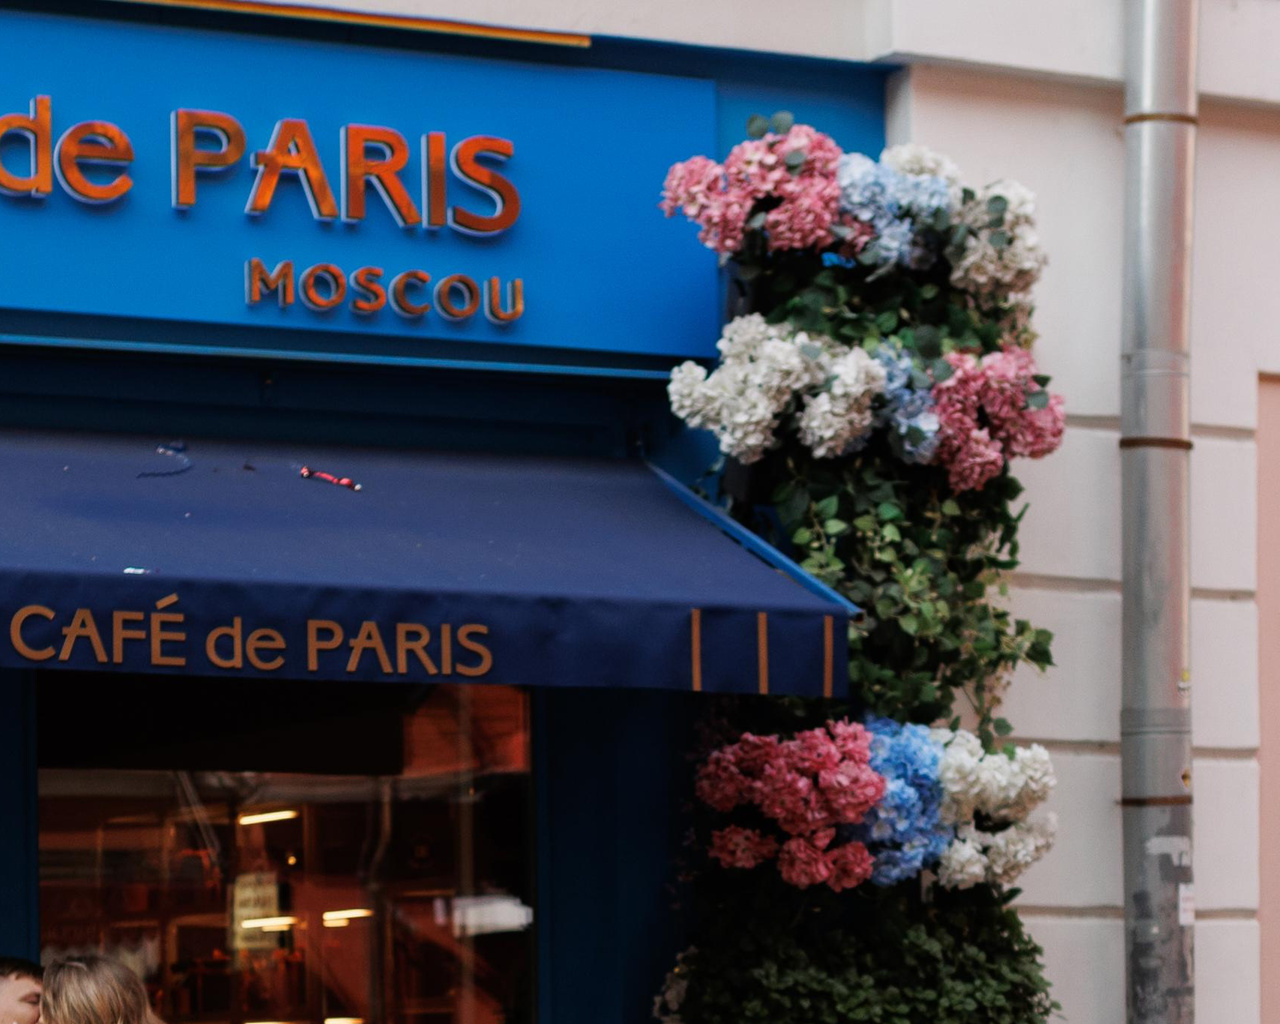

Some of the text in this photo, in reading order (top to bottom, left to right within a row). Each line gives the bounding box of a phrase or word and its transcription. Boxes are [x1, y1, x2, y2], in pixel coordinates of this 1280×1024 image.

[172, 108, 521, 236] PARIS
[246, 257, 524, 323] MOSCOU
[10, 593, 494, 677] CAFÉ de PARIS
